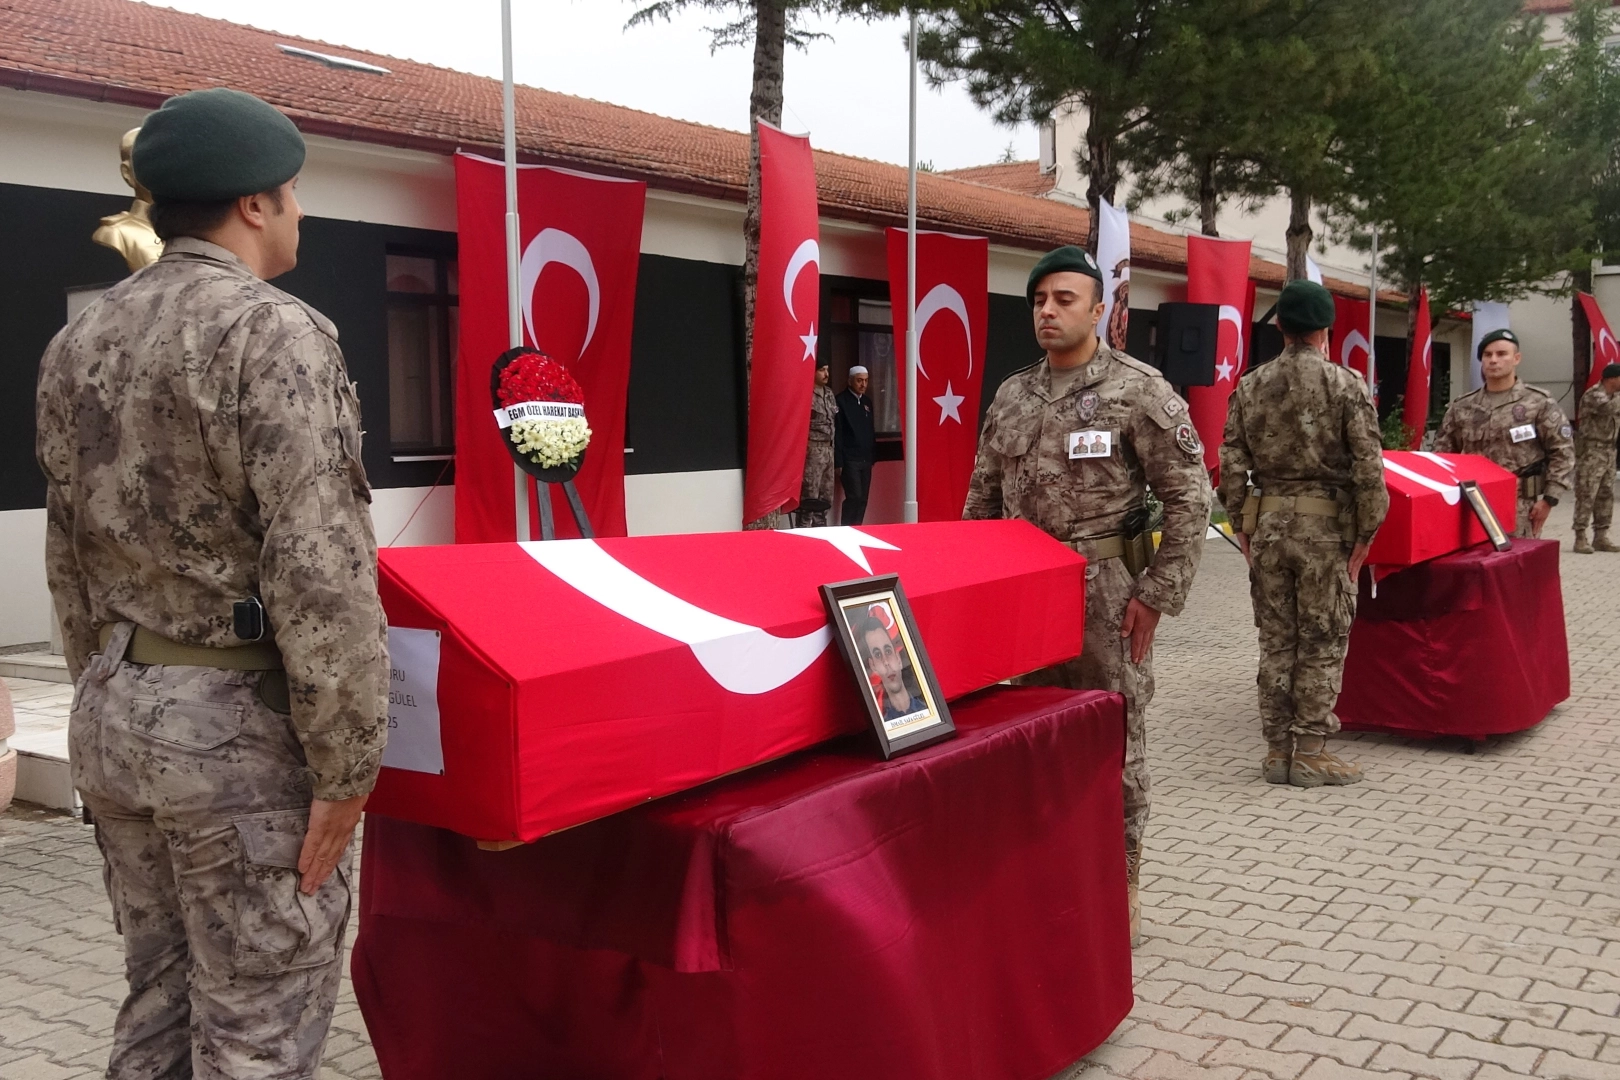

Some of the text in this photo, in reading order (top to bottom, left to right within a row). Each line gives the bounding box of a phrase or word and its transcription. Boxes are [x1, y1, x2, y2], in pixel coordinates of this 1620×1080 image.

[508, 407, 526, 420] EGM
[526, 404, 542, 415] ÖZEL
[542, 405, 567, 417] HAREKAT
[389, 690, 417, 707] GÜLEL
